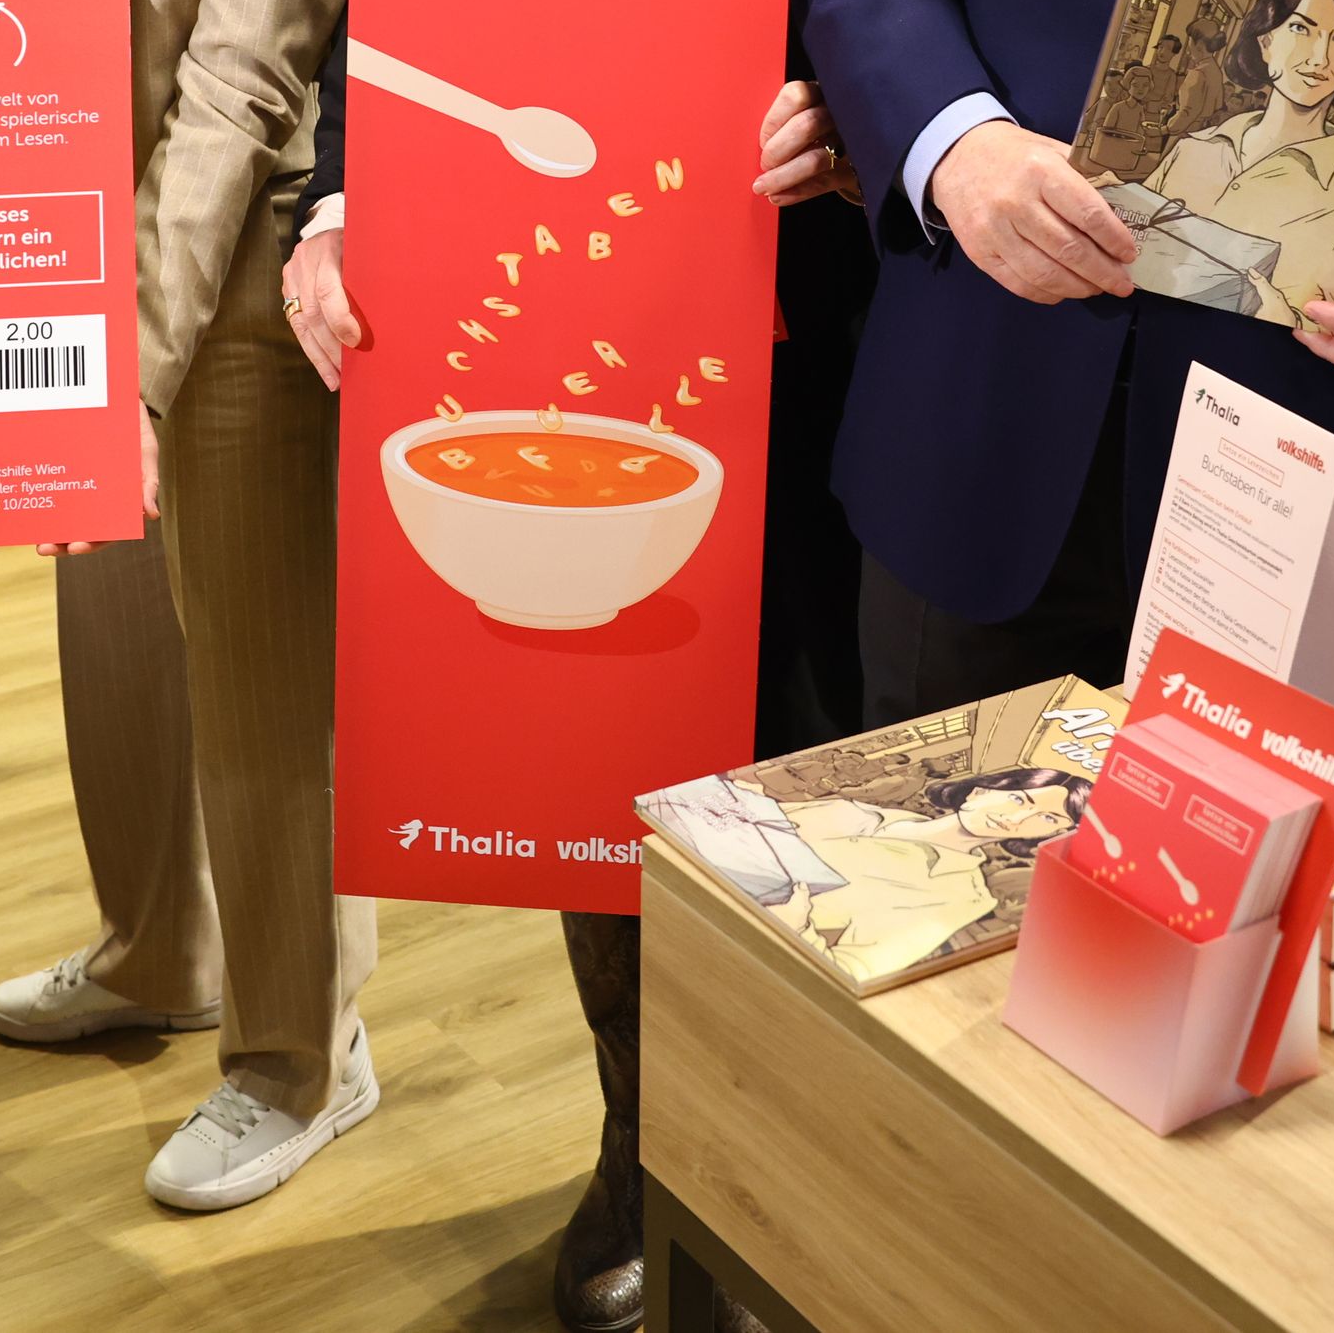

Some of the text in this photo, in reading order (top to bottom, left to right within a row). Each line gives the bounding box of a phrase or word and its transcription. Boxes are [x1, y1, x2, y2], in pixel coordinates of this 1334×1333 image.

[27, 93, 59, 107] von
[0, 108, 99, 128] spielerische
[15, 131, 68, 146] Lesen.
[21, 228, 51, 244] ein
[6, 322, 53, 343] 2,00
[1206, 394, 1326, 474] Thalia volkshilfe.
[35, 464, 65, 476] Wien
[21, 478, 97, 494] flyeralarm.at,
[1201, 455, 1294, 518] Buchstaben für alle!
[2, 496, 56, 512] 10/2025.
[1181, 681, 1254, 741] Thalia
[427, 826, 642, 865] Thalia volksh
